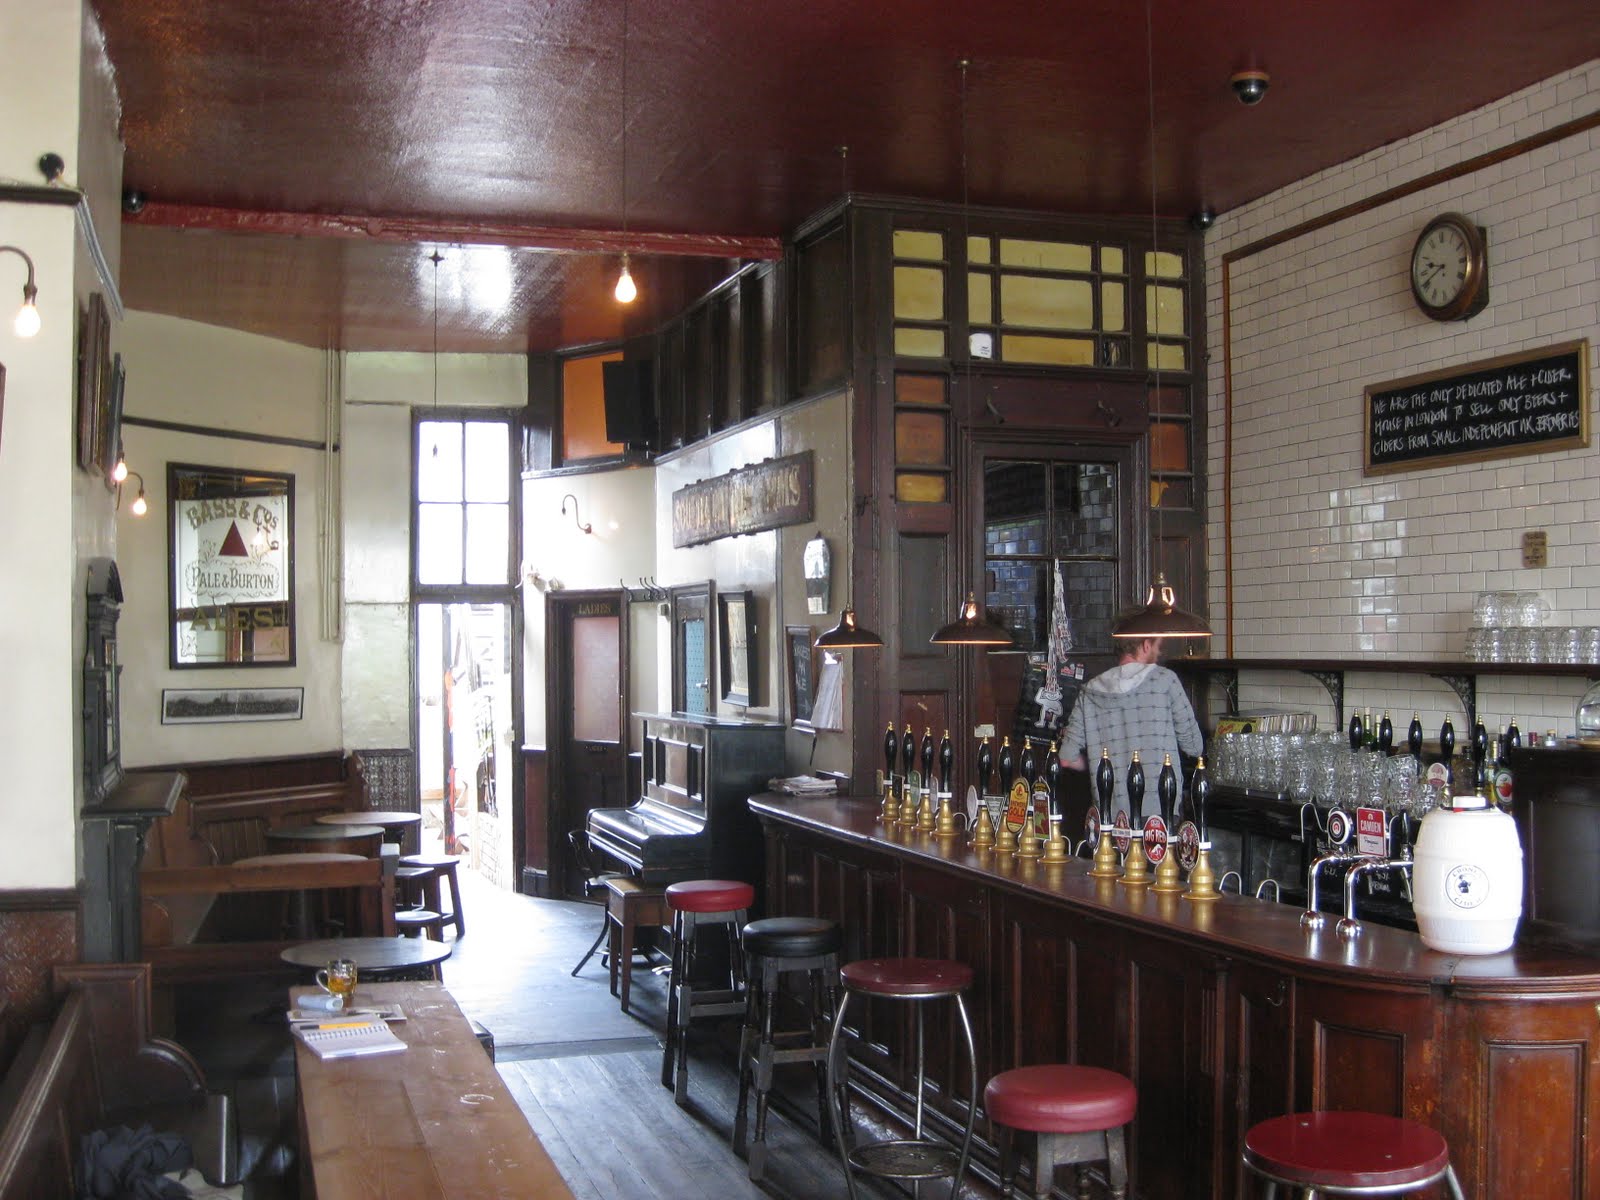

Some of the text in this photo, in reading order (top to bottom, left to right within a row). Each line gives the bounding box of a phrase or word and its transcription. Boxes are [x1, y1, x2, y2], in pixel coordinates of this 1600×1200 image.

[1374, 400, 1387, 414] WE
[1390, 397, 1409, 411] ARE
[1411, 392, 1426, 408] THE
[1431, 388, 1453, 403] ONLY
[1456, 379, 1502, 400] DEDICATED
[1507, 375, 1527, 390] ALE
[1374, 417, 1402, 436] HOUSE
[1404, 416, 1414, 431] IN
[1416, 407, 1448, 426] LONDON
[1453, 405, 1463, 420] TO
[1469, 402, 1493, 417] SELL
[1498, 395, 1523, 413] ONLY
[1524, 392, 1556, 410] BEERS
[1373, 437, 1404, 456] CIDERS
[1408, 434, 1429, 450] FROM
[1432, 430, 1460, 447] SMALL
[186, 498, 237, 529] BASS
[239, 500, 250, 520] &
[192, 567, 221, 588] PALE
[230, 567, 274, 589] BURTON
[190, 606, 274, 631] ALES
[578, 603, 611, 615] LADIES
[1009, 806, 1025, 817] GOLD
[1145, 829, 1155, 841] BIG
[1360, 819, 1381, 834] CAMDEN
